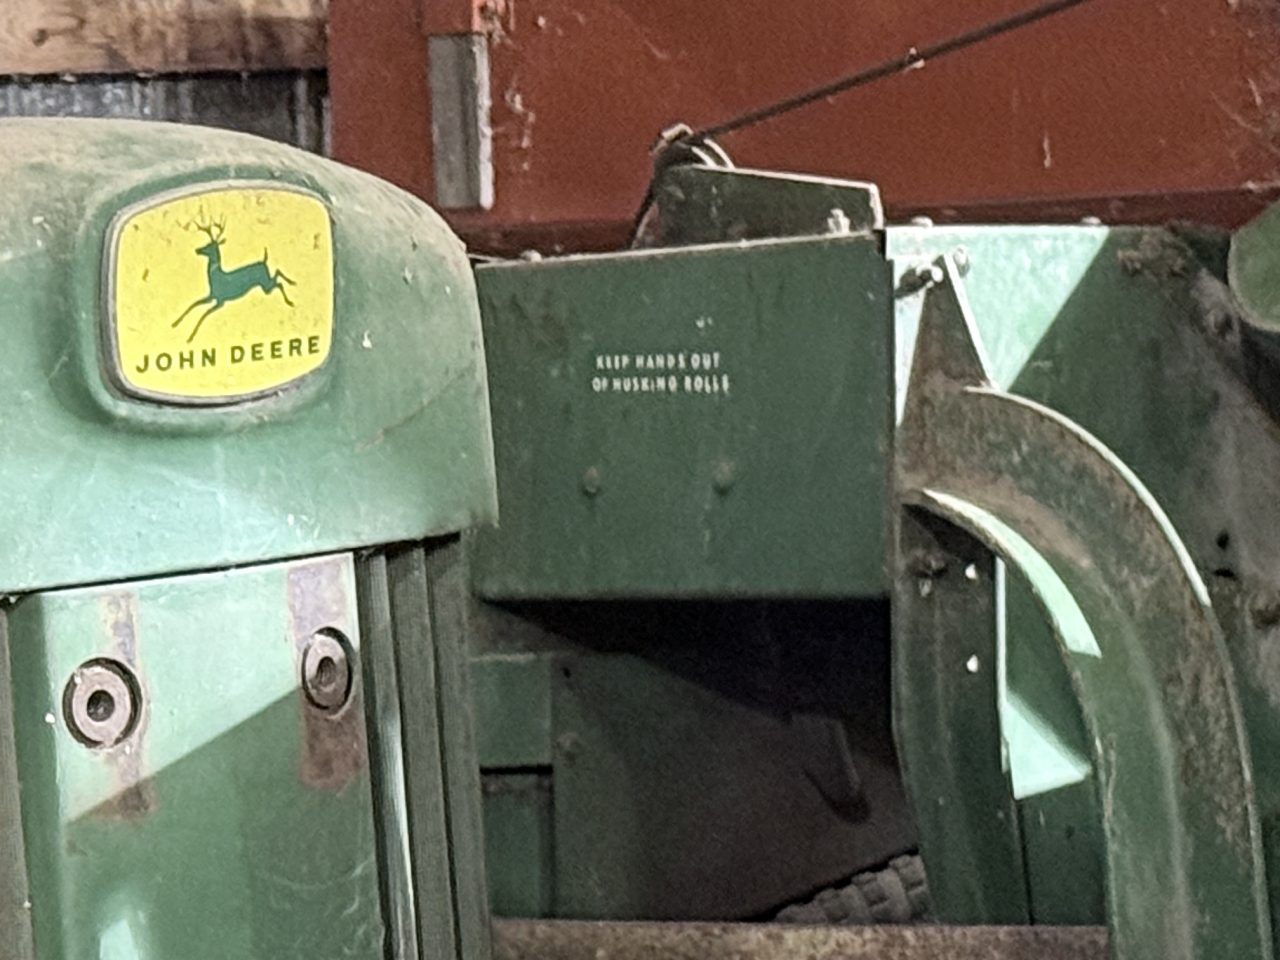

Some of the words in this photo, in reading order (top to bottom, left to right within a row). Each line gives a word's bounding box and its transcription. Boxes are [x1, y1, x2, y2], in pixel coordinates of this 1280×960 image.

[136, 347, 216, 374] JOHN
[230, 335, 320, 364] DEERE
[635, 353, 686, 370] HANDS
[690, 351, 720, 370] OUT
[592, 376, 609, 392] OF
